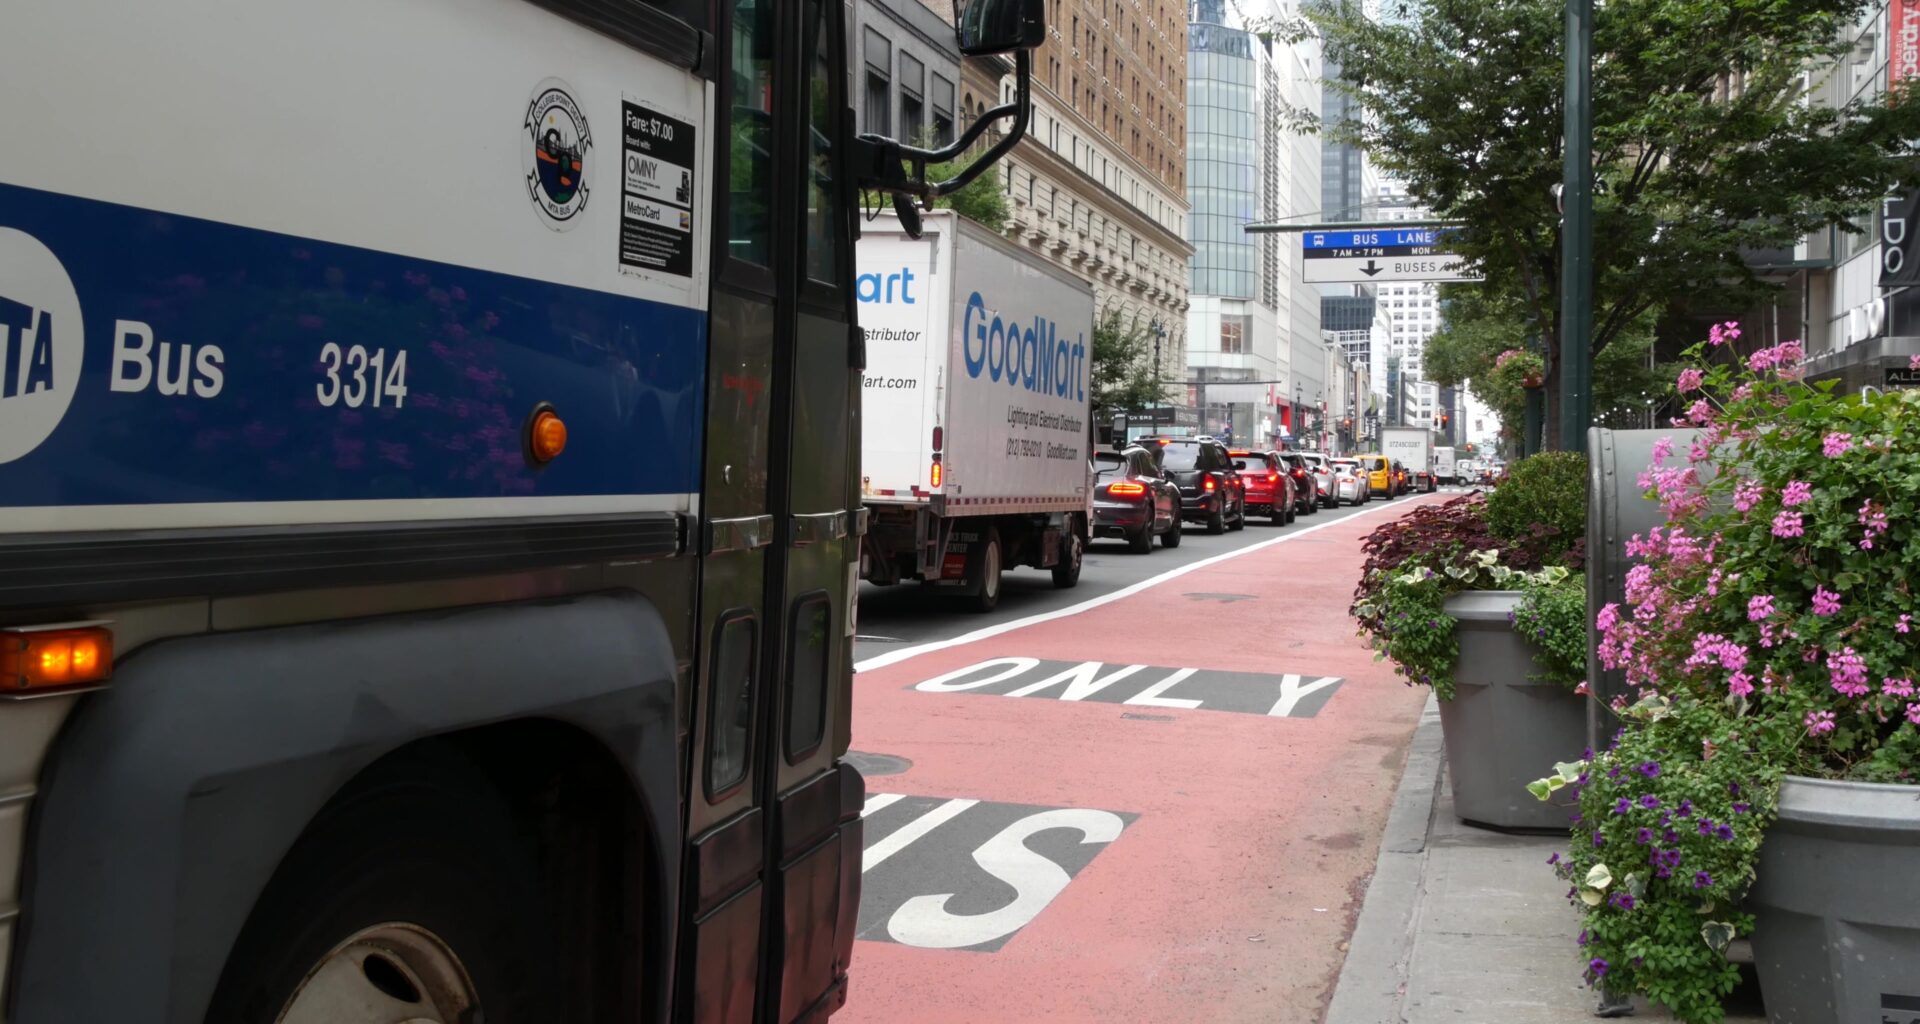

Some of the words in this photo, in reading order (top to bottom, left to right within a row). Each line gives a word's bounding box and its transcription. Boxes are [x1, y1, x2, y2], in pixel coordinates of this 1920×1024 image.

[1903, 7, 1920, 82] perdry
[535, 94, 556, 119] COLLEGE
[556, 94, 571, 109] POINT
[570, 105, 585, 134] DEPOT
[626, 110, 649, 133] Fare:
[650, 117, 674, 142] $7.00
[625, 134, 640, 147] Board
[640, 139, 652, 150] with:
[628, 155, 658, 180] OMNY
[547, 201, 559, 214] MTA
[560, 205, 571, 216] BUS
[626, 200, 661, 221] MetroCard
[1353, 233, 1379, 245] BUS
[1397, 232, 1432, 244] LANE
[1411, 247, 1430, 255] MON
[1395, 262, 1436, 273] BUSES
[110, 320, 225, 399] Bus
[963, 291, 1085, 402] GoodMart
[316, 342, 407, 408] 3314
[1007, 405, 1029, 430] Lighting
[1029, 410, 1039, 426] and
[1039, 411, 1060, 430] Electrical
[1060, 414, 1082, 433] Distributor
[1006, 437, 1020, 460] (212)
[1046, 442, 1077, 460] GoodMart.com
[914, 656, 1343, 717] ONLY
